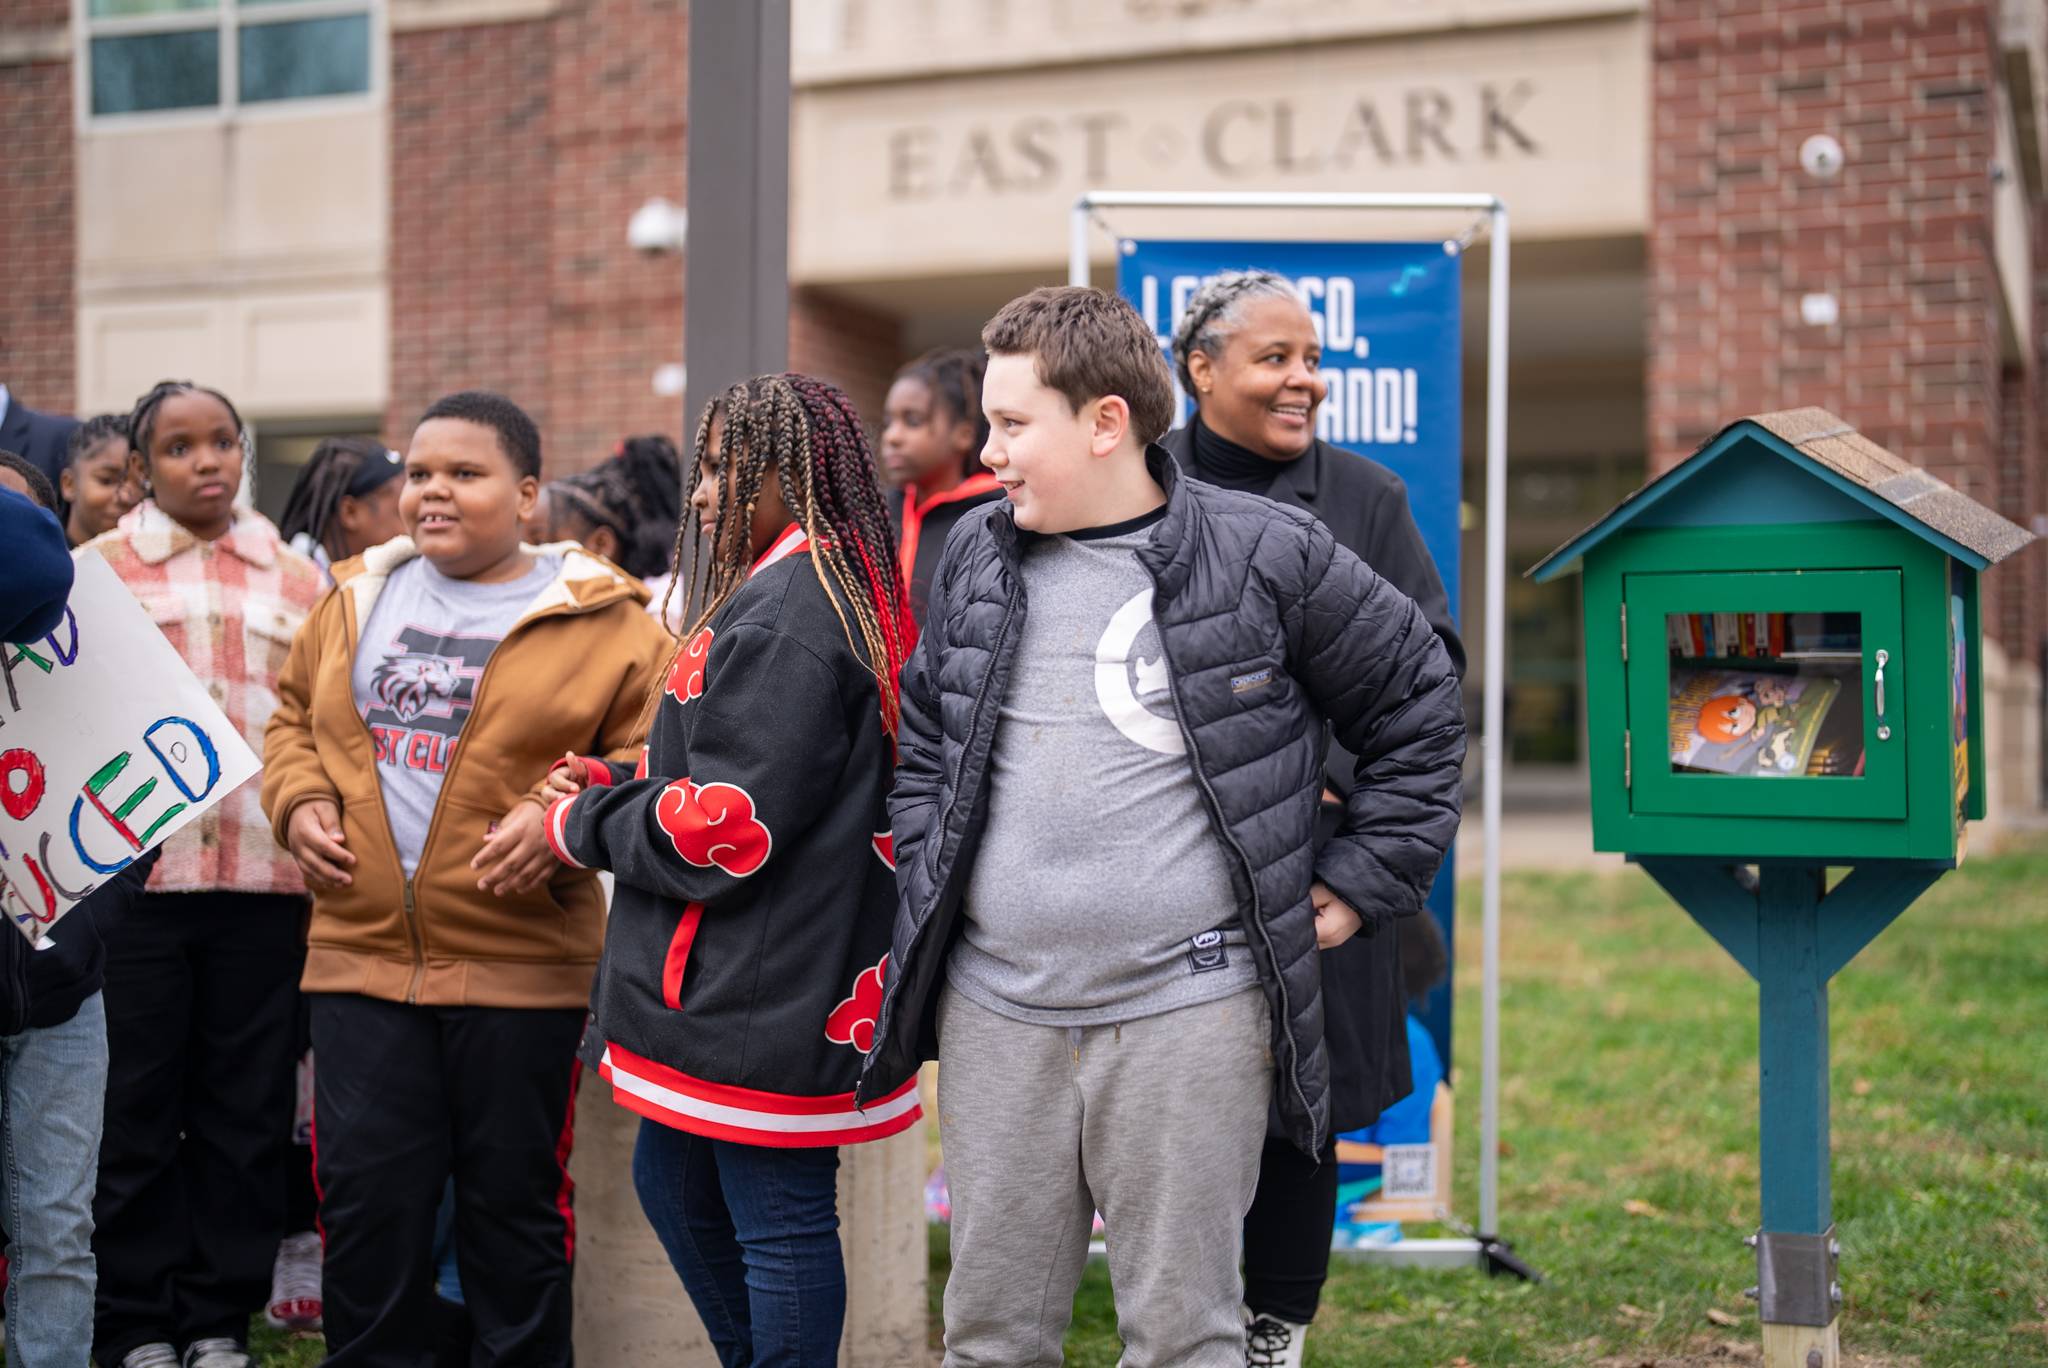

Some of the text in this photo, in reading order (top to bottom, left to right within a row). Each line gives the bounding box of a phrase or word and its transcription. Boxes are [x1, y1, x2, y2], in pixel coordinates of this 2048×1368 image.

[885, 79, 1543, 199] EAST CLARK
[1315, 366, 1418, 444] AND!
[371, 726, 407, 766] ST
